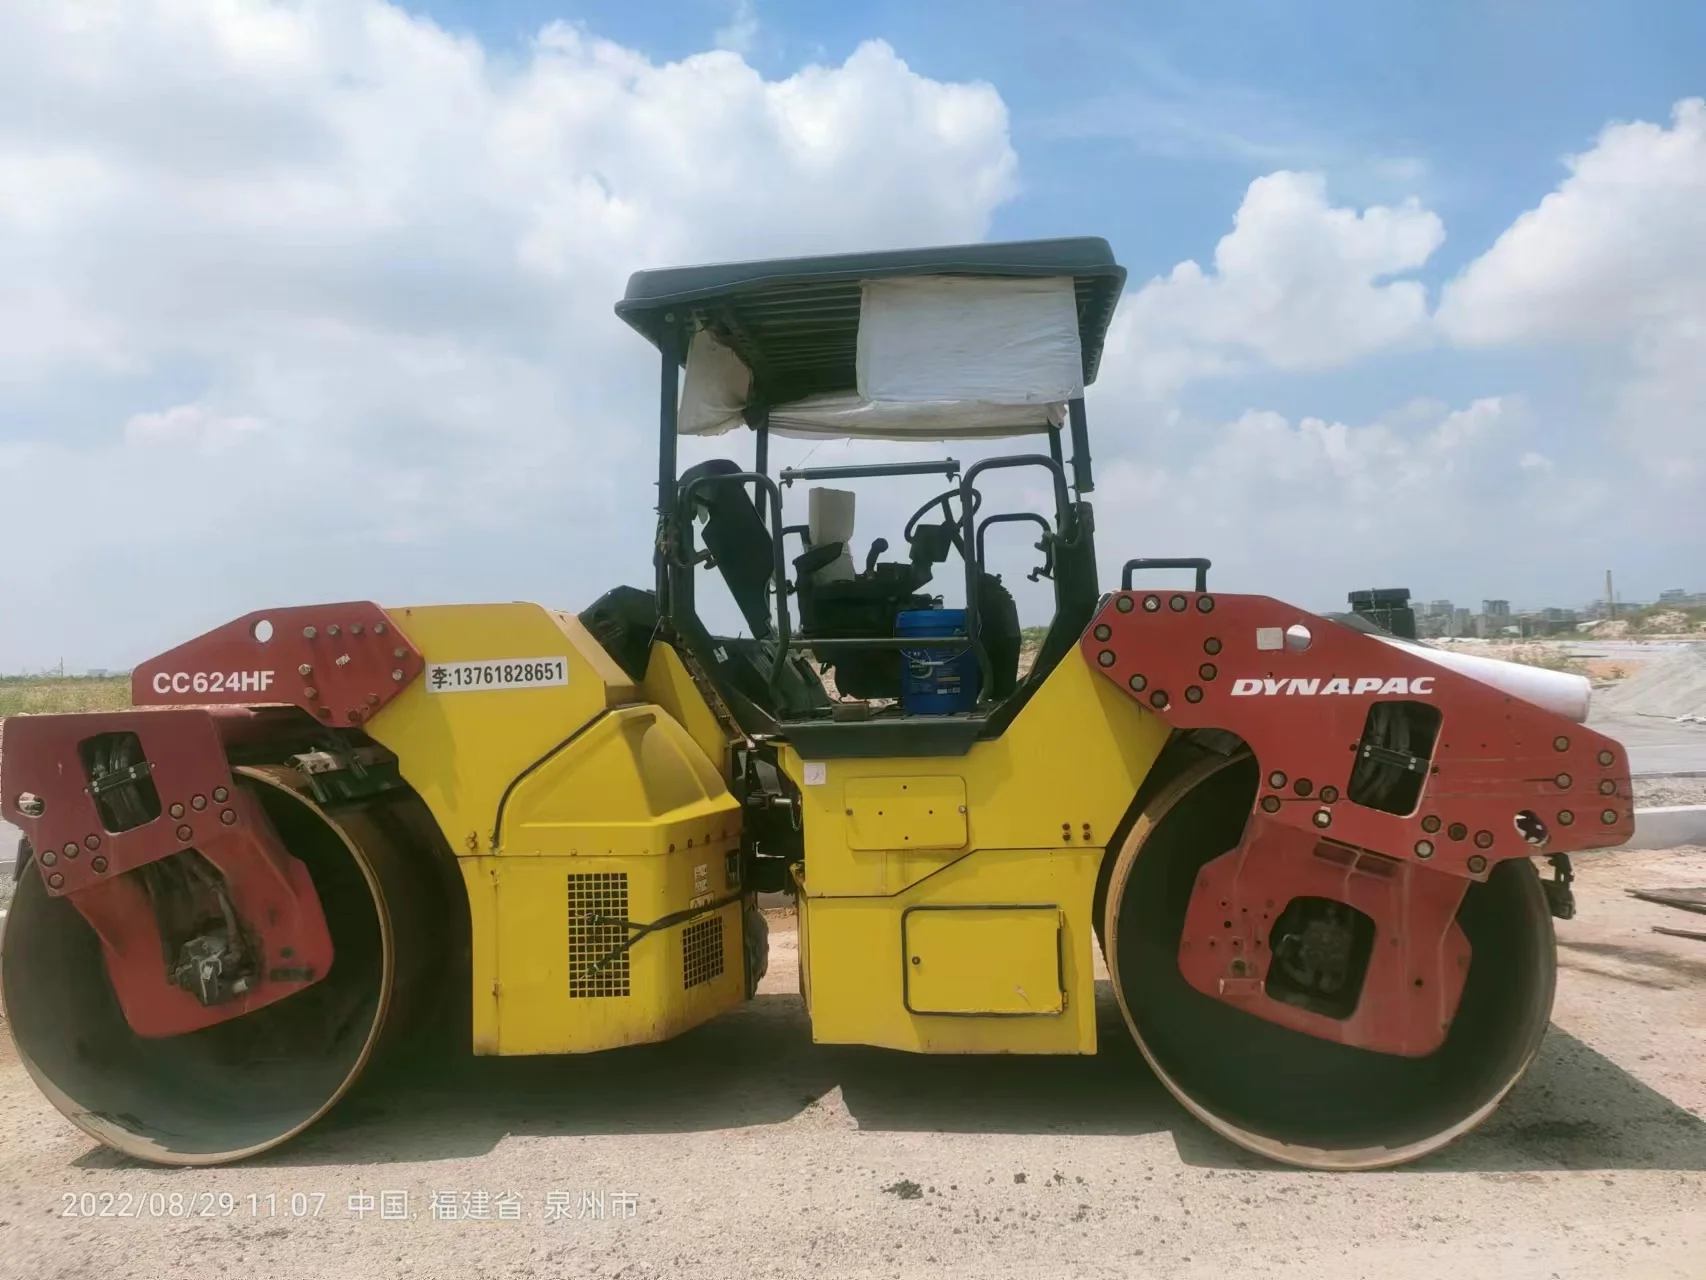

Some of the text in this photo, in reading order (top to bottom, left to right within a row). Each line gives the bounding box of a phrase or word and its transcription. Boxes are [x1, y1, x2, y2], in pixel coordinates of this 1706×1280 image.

[152, 670, 275, 695] CC624HF
[431, 662, 565, 690] 李:13761828651
[1230, 677, 1435, 696] DYNAPAC
